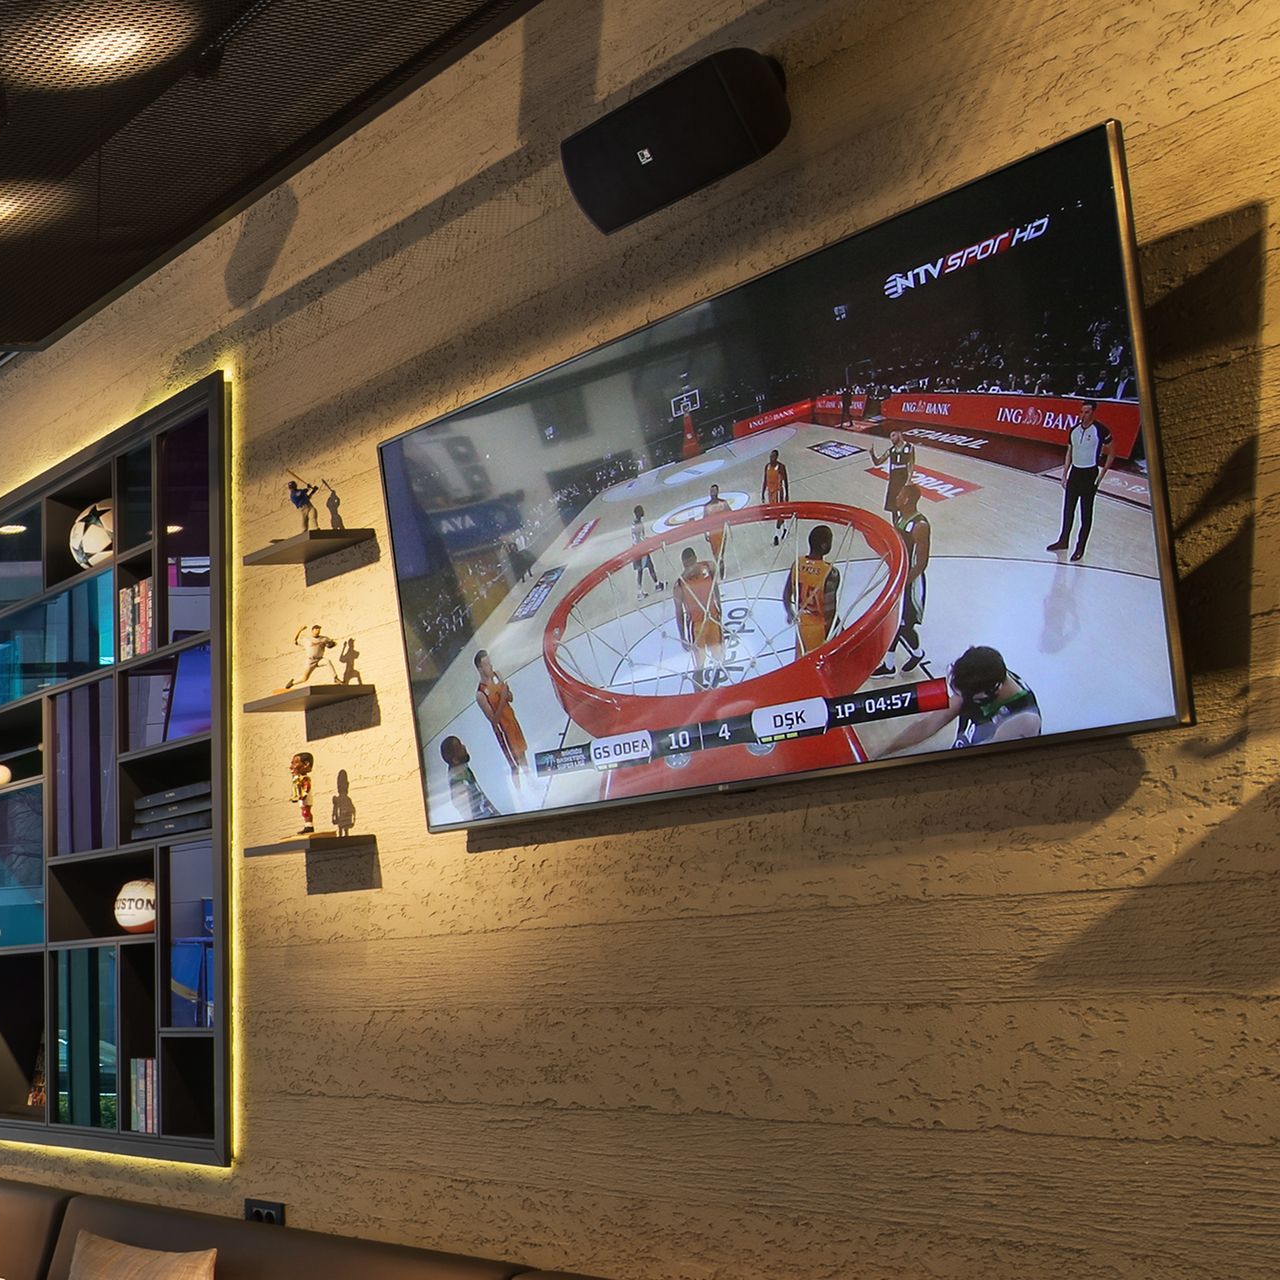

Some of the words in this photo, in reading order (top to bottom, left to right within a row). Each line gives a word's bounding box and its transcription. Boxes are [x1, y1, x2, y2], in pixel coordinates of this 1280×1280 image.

[1011, 217, 1049, 247] HD
[926, 403, 950, 415] BANK
[997, 407, 1023, 424] ING
[836, 702, 856, 719] 1P
[865, 692, 912, 714] 04:57
[773, 709, 807, 730] DŞK
[668, 731, 690, 750] 10
[718, 723, 731, 741] 4
[593, 745, 611, 760] GS
[614, 738, 650, 757] ODEA
